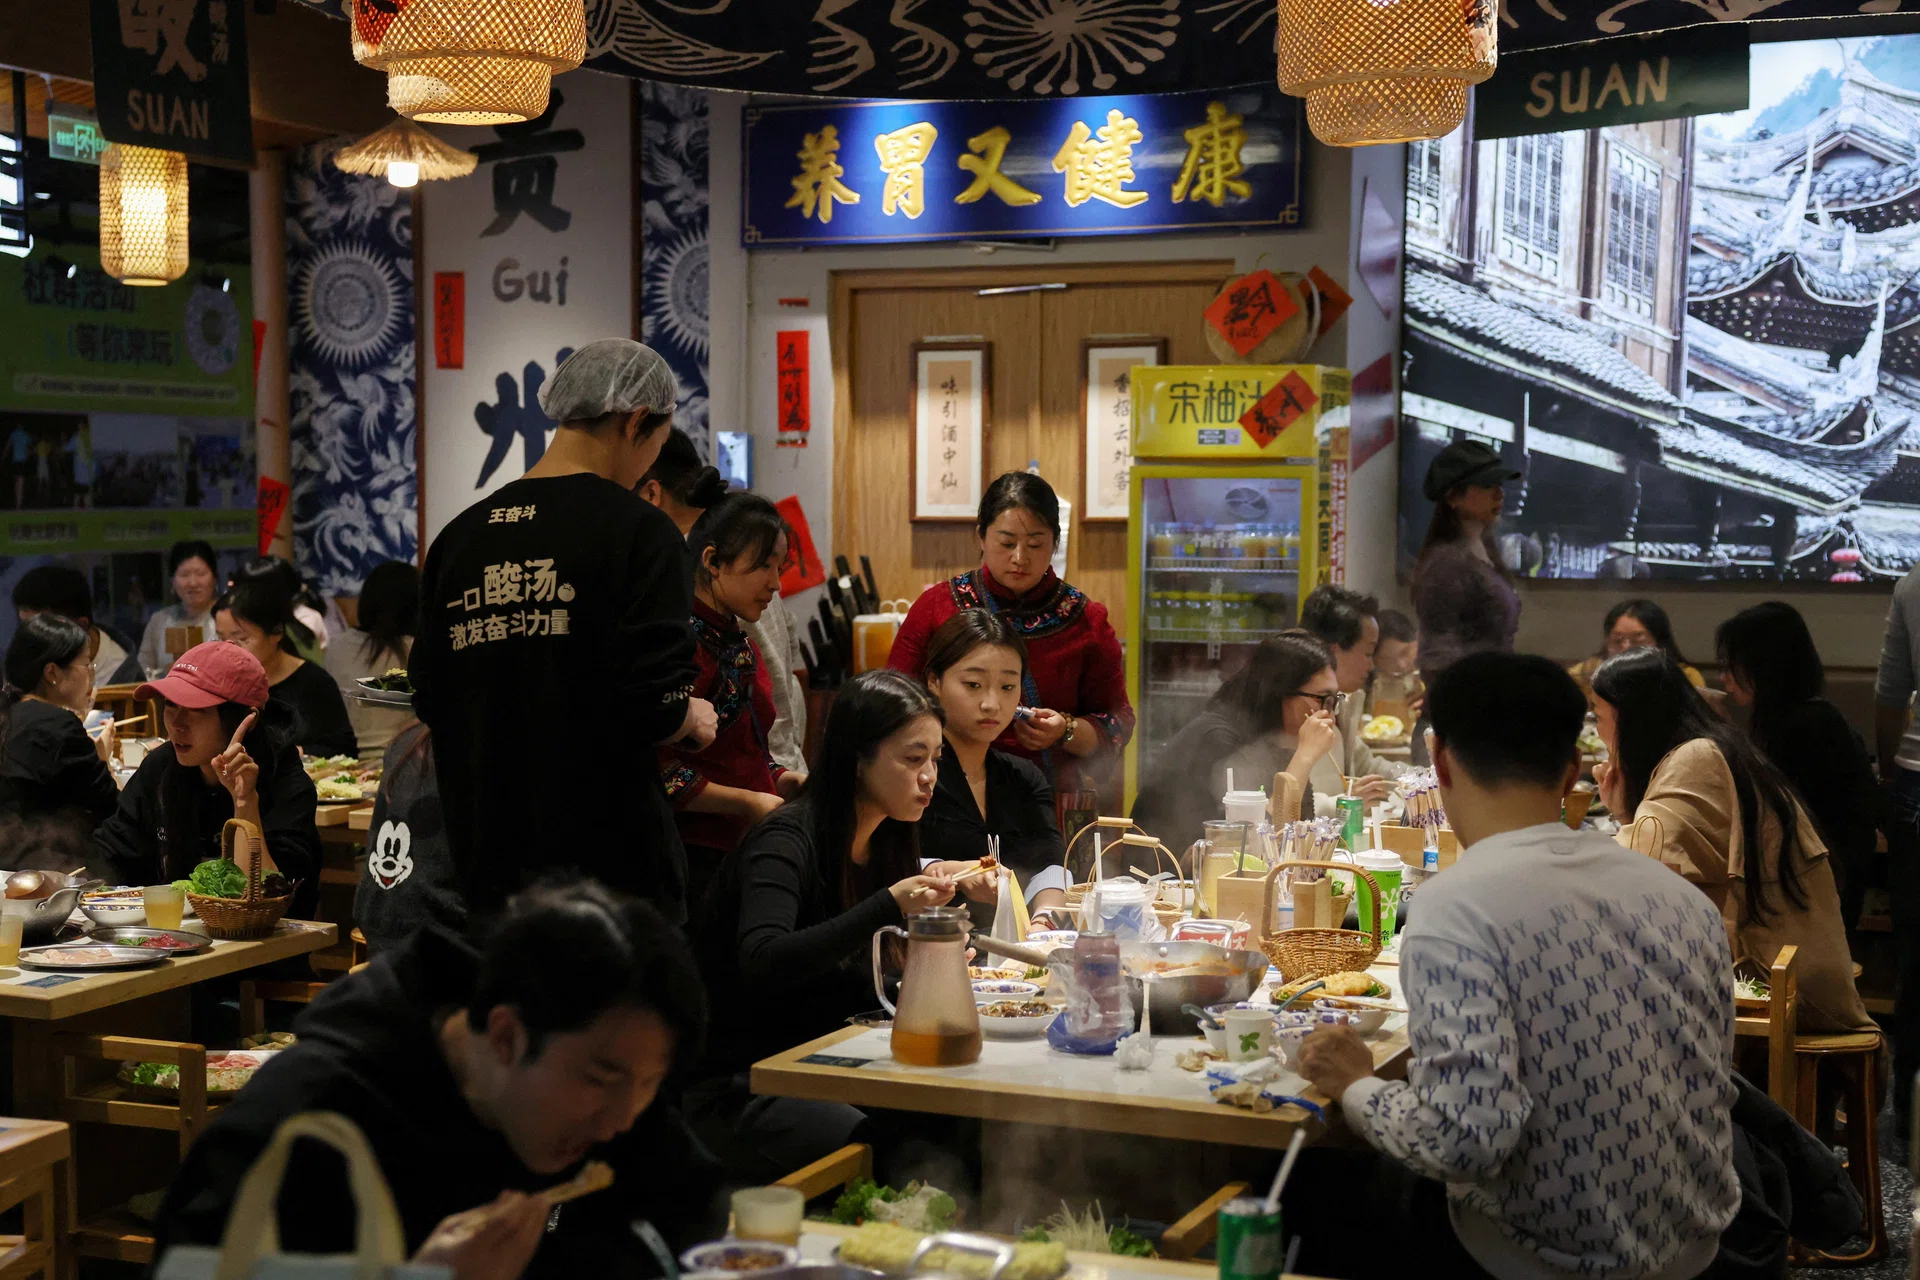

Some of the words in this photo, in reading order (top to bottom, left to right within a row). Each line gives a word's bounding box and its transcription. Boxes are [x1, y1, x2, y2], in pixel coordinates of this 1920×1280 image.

[1525, 56, 1670, 119] SUAN
[127, 88, 209, 141] SUAN
[785, 101, 1254, 224] 养胃又健康
[492, 256, 569, 306] Gui
[940, 373, 959, 490] 味引酒中仙
[487, 504, 537, 524] 王奋斗
[446, 558, 558, 612] 一口酸汤
[448, 608, 572, 652] 激发奋斗力量
[1568, 935, 1594, 960] NY
[1600, 949, 1627, 971] NY
[1427, 963, 1457, 986] NY
[1548, 962, 1577, 988] NY
[1583, 972, 1608, 996] NY
[1527, 988, 1555, 1016] NY
[1613, 983, 1639, 1005] NY
[1643, 992, 1671, 1015] NY
[1430, 999, 1463, 1020] NY
[1561, 997, 1591, 1023] NY
[1596, 1008, 1621, 1032] NY
[1466, 1014, 1497, 1034] NY
[1627, 1017, 1650, 1041] NY
[1538, 1026, 1567, 1052] NY
[1573, 1034, 1601, 1060] NY
[1607, 1044, 1633, 1069] NY
[1548, 1062, 1577, 1088] NY
[1583, 1071, 1612, 1097] NY
[1468, 1086, 1500, 1108] NY
[1617, 1080, 1643, 1106] NY
[1555, 1097, 1586, 1122] NY
[1592, 1107, 1621, 1132] NY
[1527, 1125, 1558, 1150] NY
[1626, 1116, 1652, 1140] NY
[1562, 1133, 1594, 1158] NY
[1600, 1142, 1628, 1167] NY
[1534, 1158, 1565, 1180] NY
[1632, 1150, 1659, 1177] NY
[1570, 1168, 1601, 1192] NY
[1605, 1177, 1632, 1202] NY
[1541, 1193, 1572, 1215] NY
[1636, 1184, 1661, 1209] NY
[1578, 1203, 1607, 1226] NY
